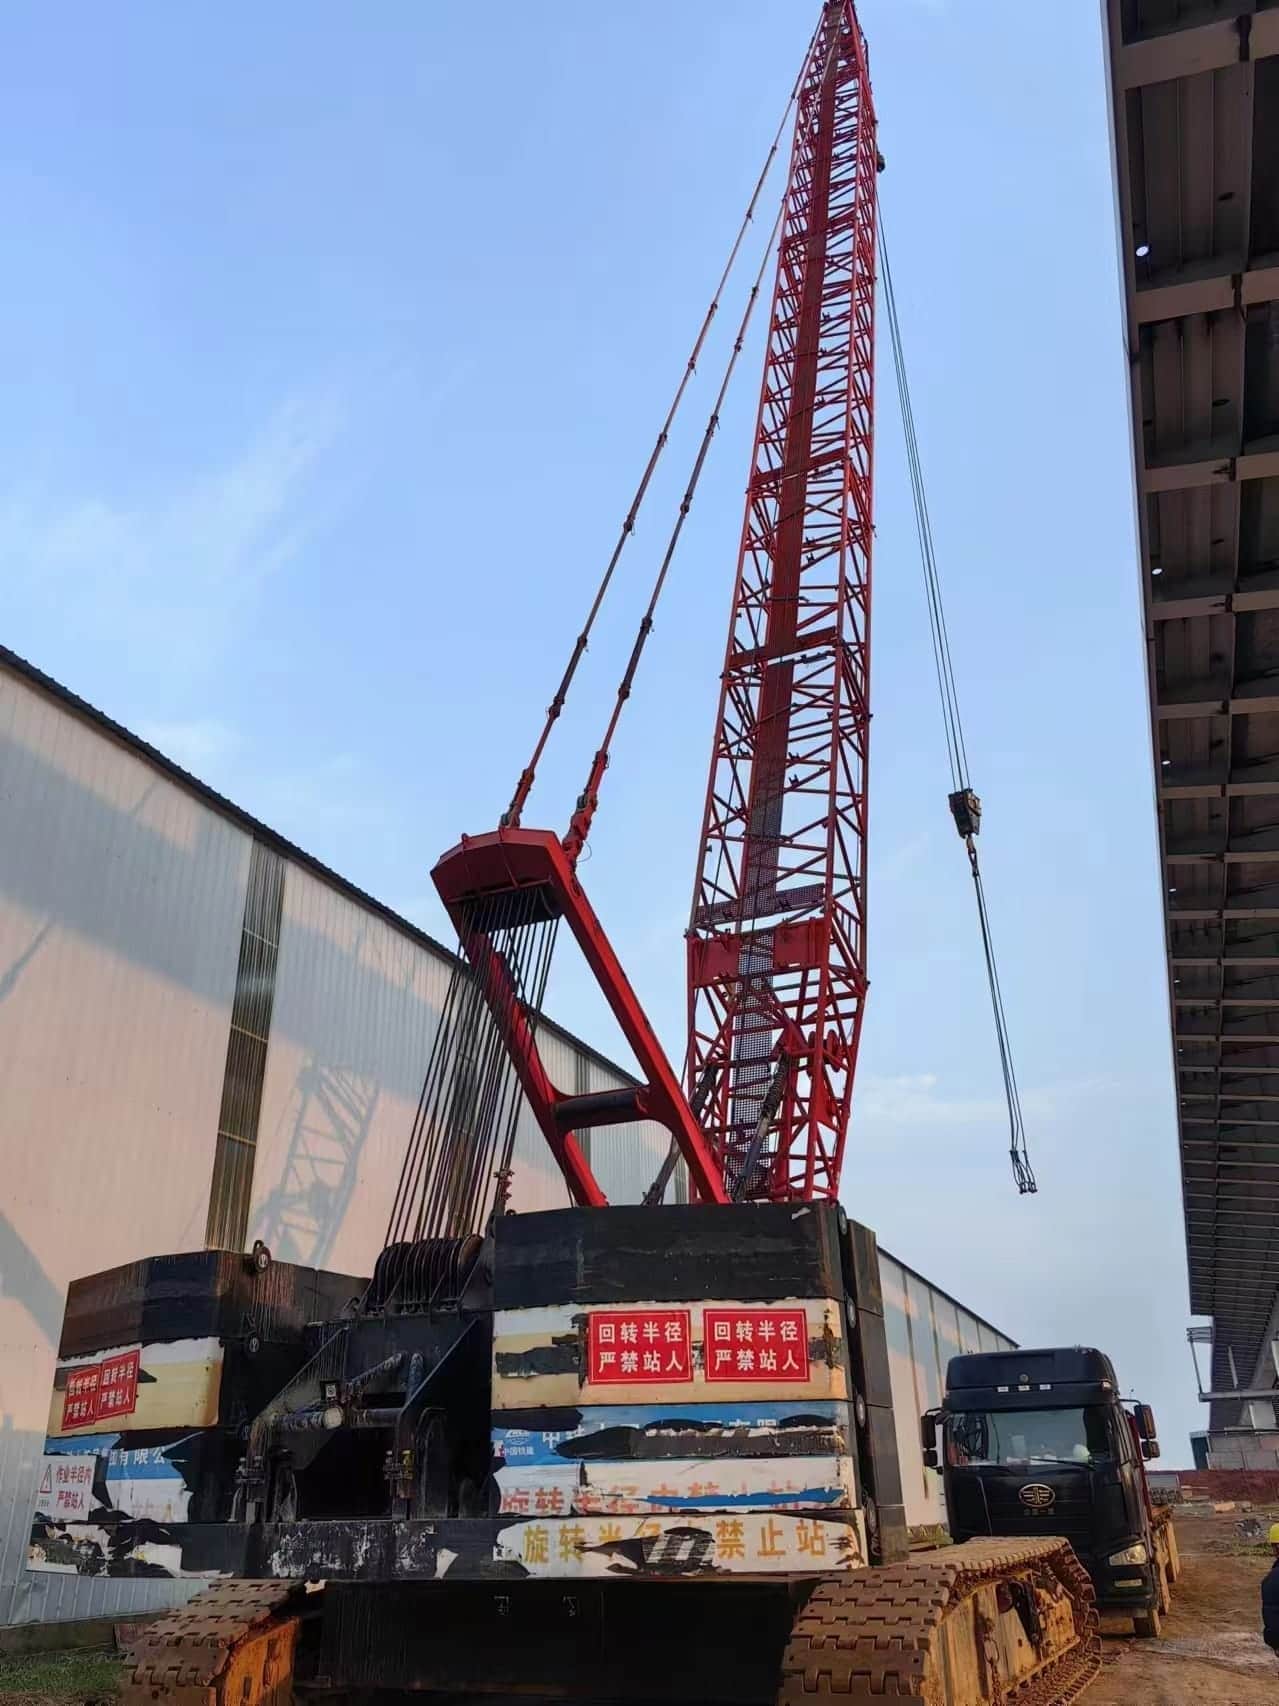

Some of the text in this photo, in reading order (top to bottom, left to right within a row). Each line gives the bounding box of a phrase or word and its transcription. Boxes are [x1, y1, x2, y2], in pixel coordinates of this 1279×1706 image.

[599, 1321, 683, 1344] 回转半径
[714, 1319, 799, 1342] 回转半径
[598, 1349, 683, 1373] 严禁站人
[714, 1348, 800, 1371] 严禁站人
[102, 1361, 134, 1386] 回转半径
[100, 1386, 131, 1409] 严禁站人
